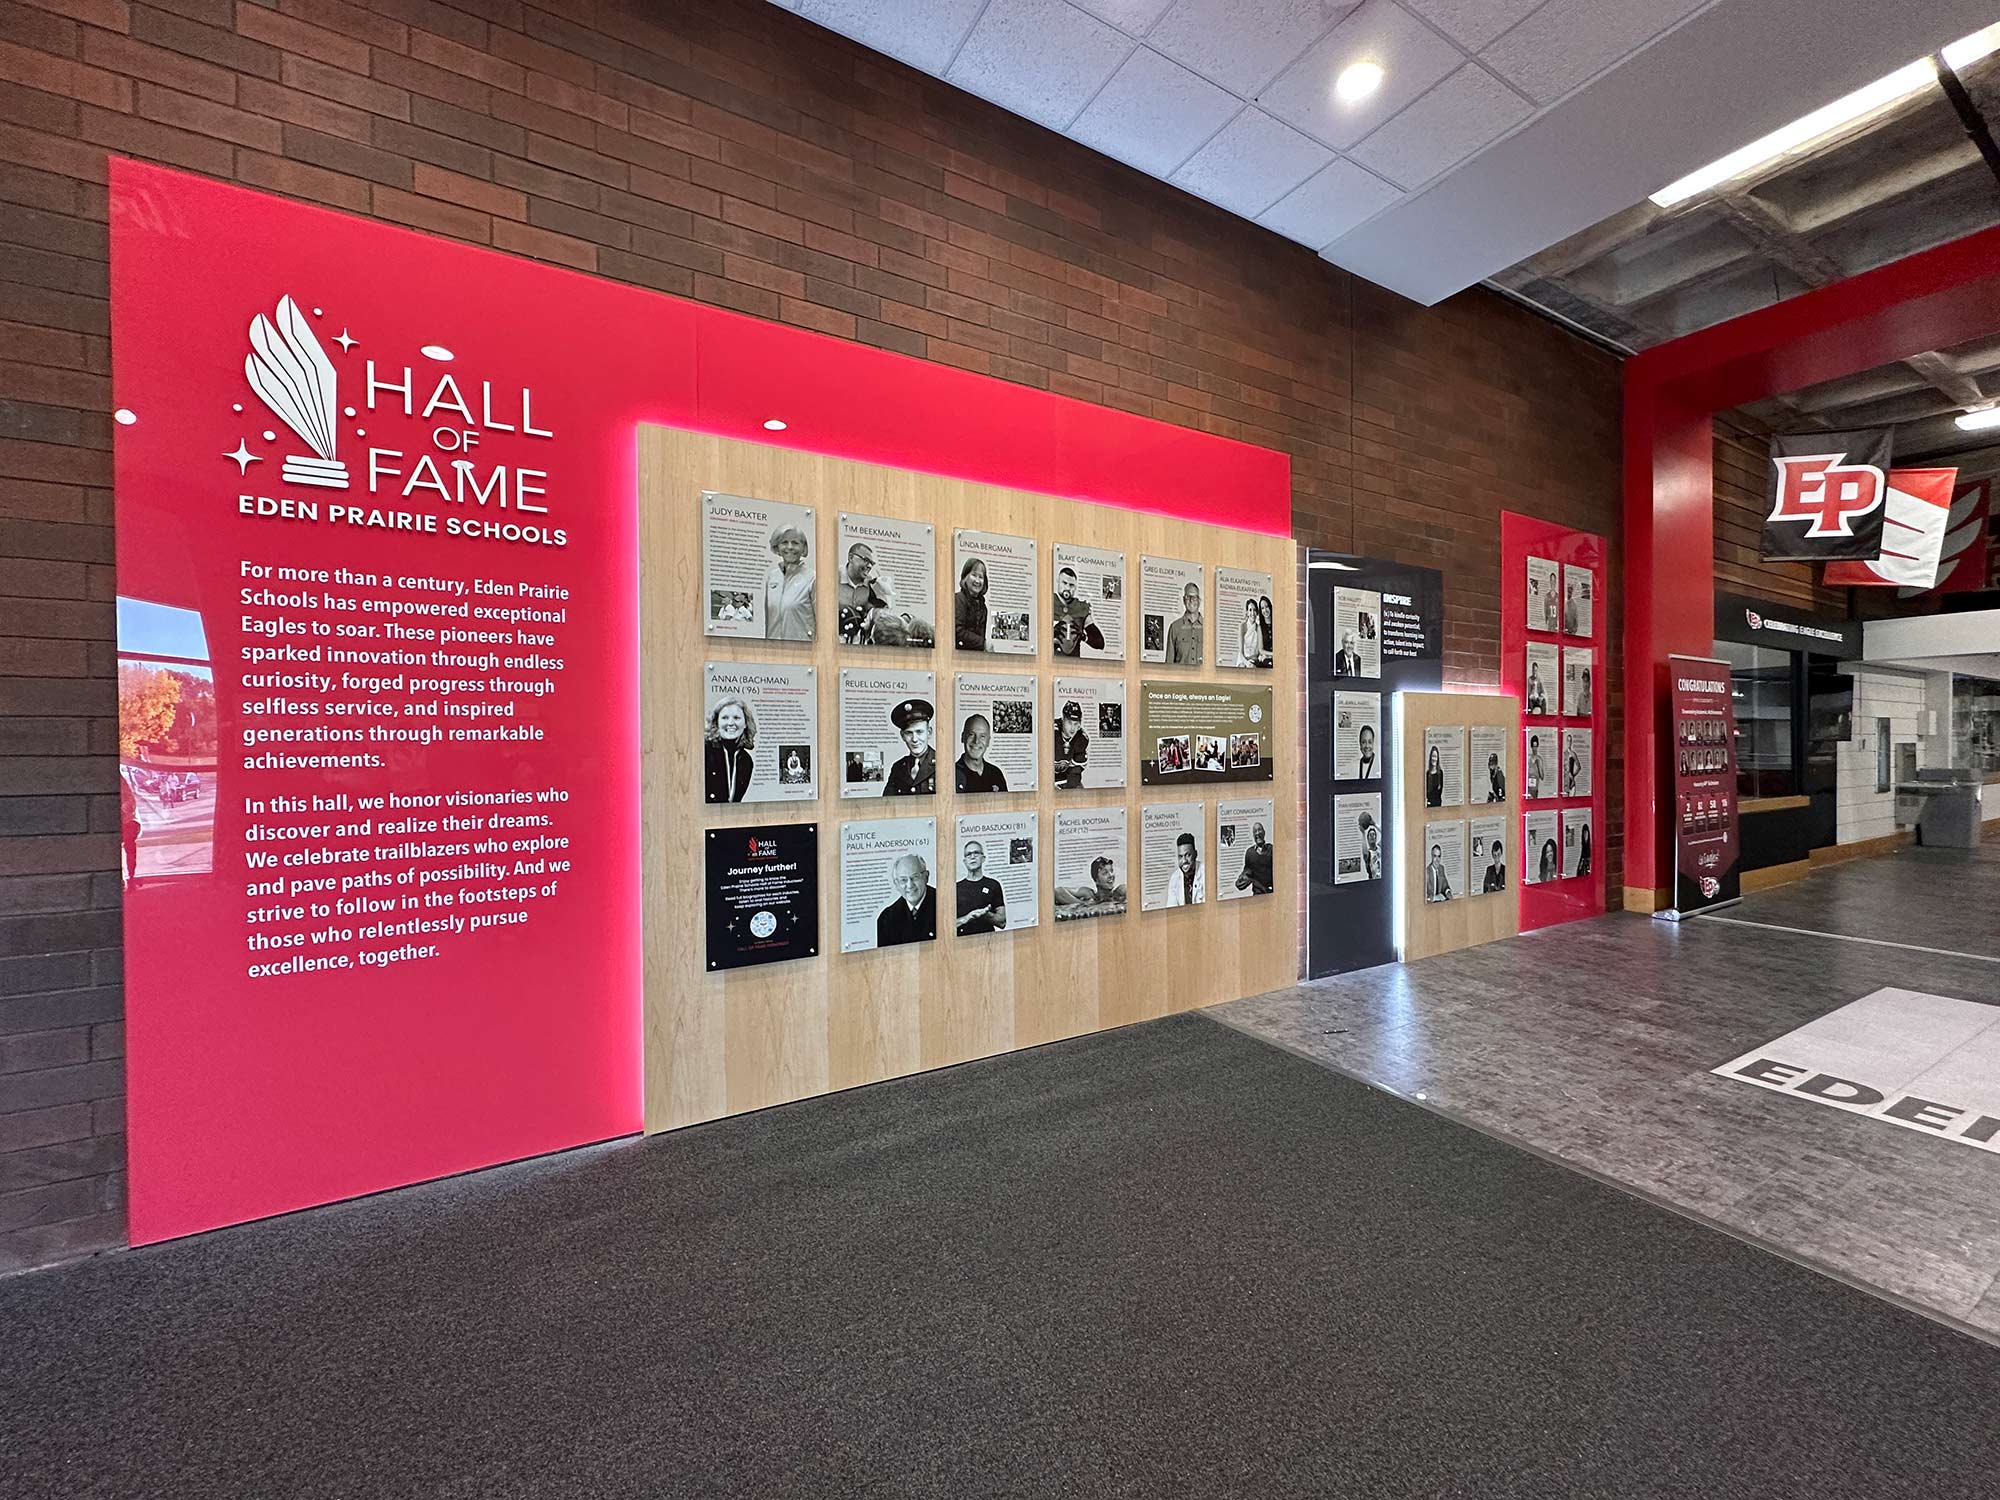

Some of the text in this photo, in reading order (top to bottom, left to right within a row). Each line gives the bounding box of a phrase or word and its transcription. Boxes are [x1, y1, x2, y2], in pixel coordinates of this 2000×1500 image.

[366, 360, 554, 438] HALL
[433, 427, 479, 452] OF
[369, 447, 548, 513] FAME
[1766, 453, 1885, 538] EP
[240, 495, 566, 545] EDEN PRAIRIE SCHOOLS
[710, 507, 768, 520] JUDY BAXTER
[844, 525, 901, 539] TIM BEEKMANN
[960, 541, 1012, 553] LINDA BERGMAN
[1058, 554, 1075, 562] BLAKE
[1077, 556, 1104, 565] CASHMAN
[241, 561, 568, 599] For more than a century, Eden Prairie
[241, 588, 565, 624] Schools has empowered exceptional
[1383, 593, 1411, 606] INSPIRE
[242, 616, 554, 645] Eagles to soar. These pioneers have
[242, 644, 563, 671] sparked innovation through endless
[242, 672, 554, 696] curiosity, forged progress through
[711, 674, 789, 686] ANNA (BACHMAN)
[711, 685, 760, 695] ITMAN ('96)
[845, 680, 908, 690] REUEL LONG ('42)
[960, 684, 980, 692] CONN
[981, 684, 1016, 693] McCARTAN
[1678, 678, 1725, 693] CONGRATULATIONS
[243, 698, 513, 720] selfless service, and inspired
[244, 725, 543, 746] generations through remarkable
[244, 752, 385, 769] achievements.
[246, 788, 568, 813] In this hall, we honor visionaries who
[246, 813, 553, 841] discover and realize their dreams.
[846, 832, 876, 841] JUSTICE
[961, 825, 980, 834] DAVID
[982, 824, 1012, 832] BASZUCKI
[246, 835, 568, 868] We celebrate trailblazers who explore
[846, 842, 864, 850] PAUL
[874, 839, 914, 848] ANDERSON
[247, 859, 570, 897] and pave paths of possibility. And we
[728, 863, 796, 875] Journey further!
[247, 881, 557, 923] strive to follow in the footsteps of
[247, 912, 527, 950] those who relentlessly pursue
[249, 944, 439, 977] excellence, together.
